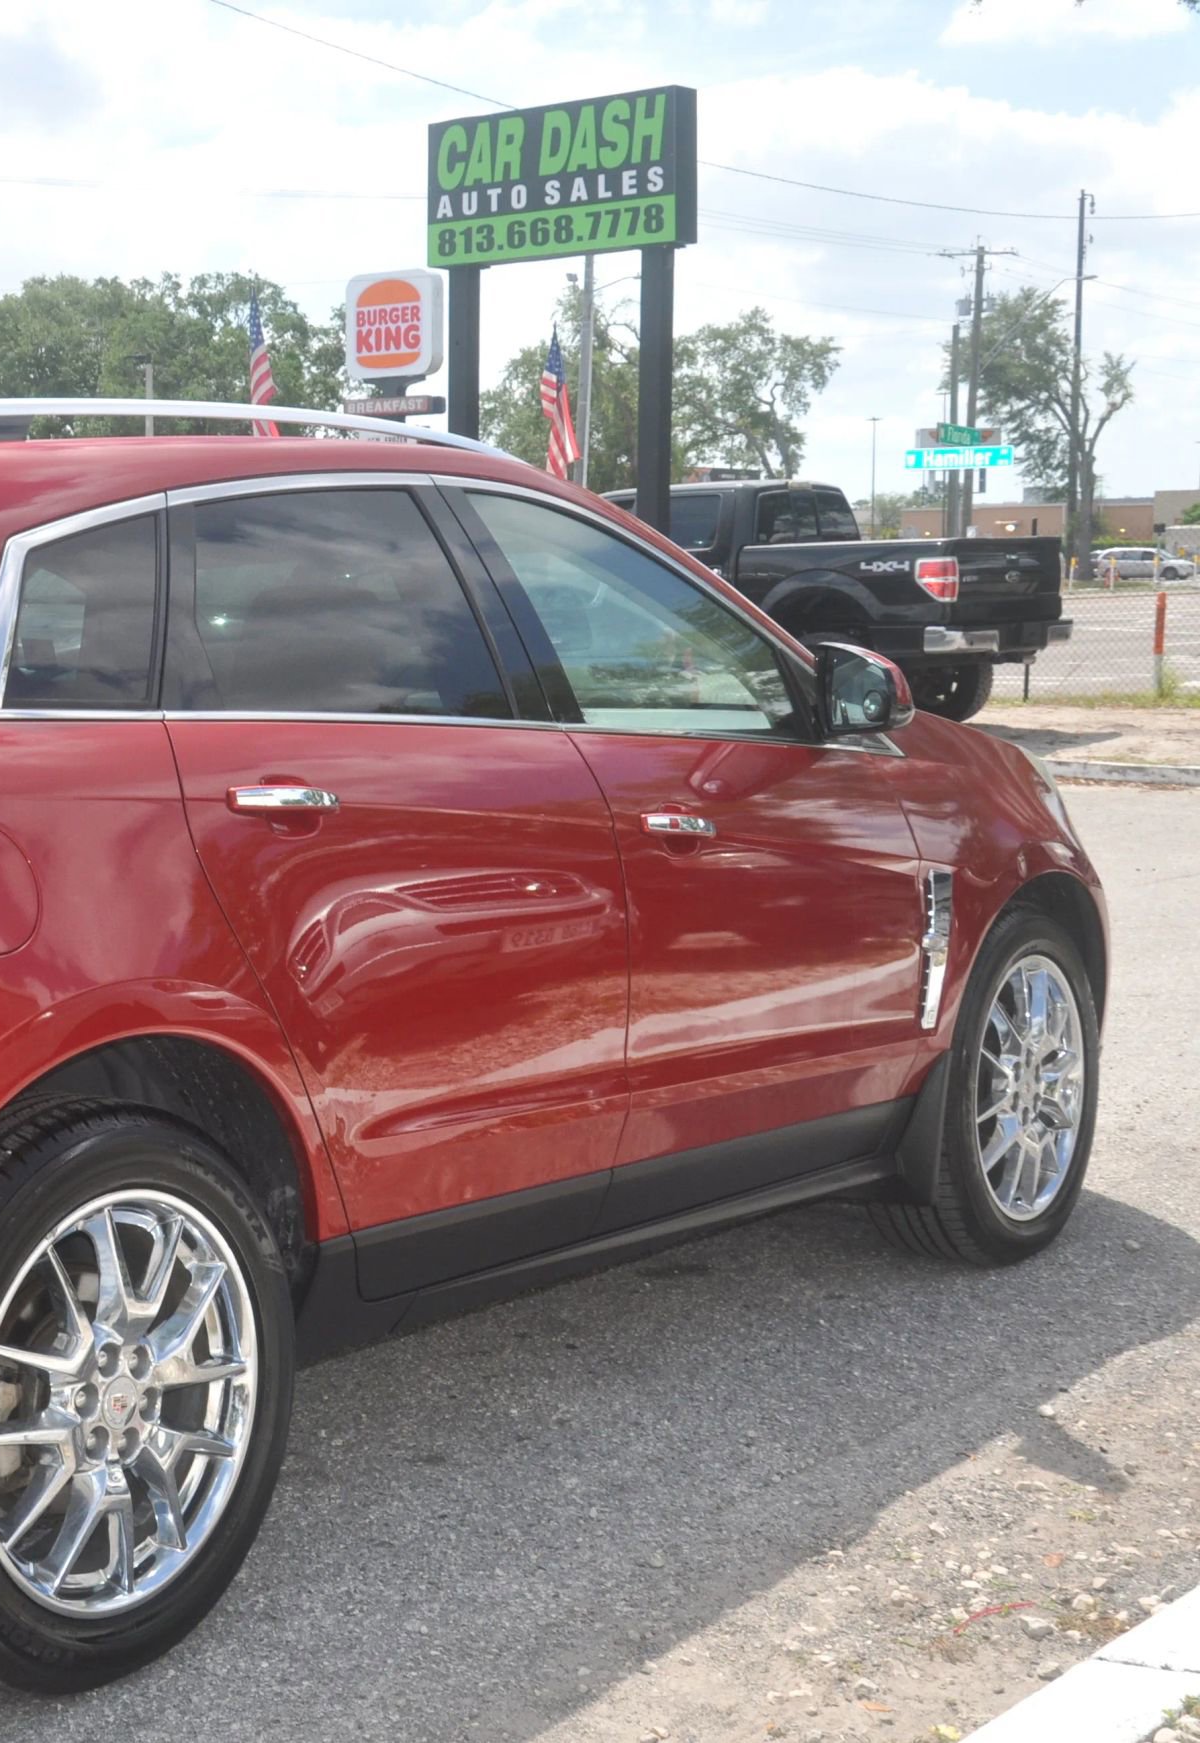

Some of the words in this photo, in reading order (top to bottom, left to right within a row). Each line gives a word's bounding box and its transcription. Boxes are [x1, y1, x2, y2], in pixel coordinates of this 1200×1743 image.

[436, 115, 525, 191] CAR
[538, 93, 666, 177] DASH
[436, 184, 528, 220] AUTO
[544, 166, 664, 206] SALES
[437, 203, 665, 257] 813.668.7778
[356, 305, 421, 328] BURGER
[356, 324, 421, 354] KING
[347, 399, 424, 414] BREAKFAST
[922, 447, 993, 467] Hamiller
